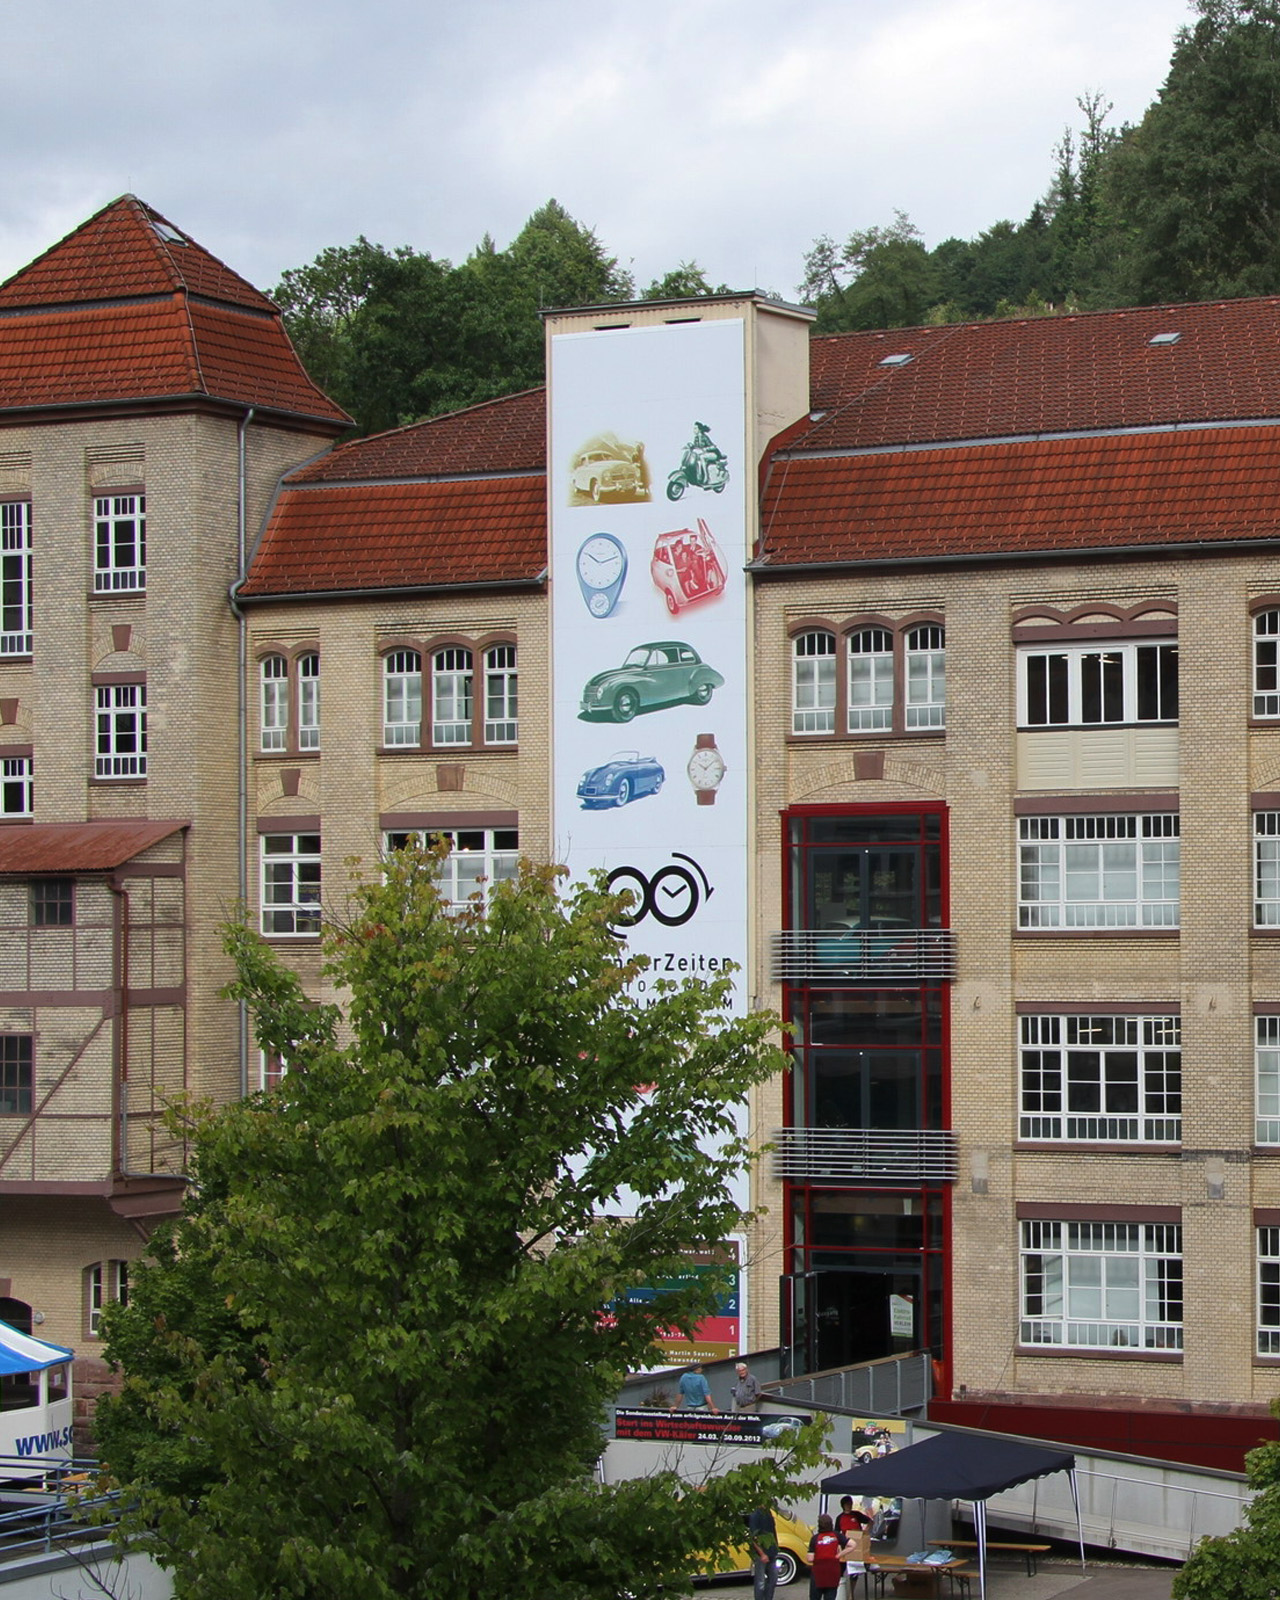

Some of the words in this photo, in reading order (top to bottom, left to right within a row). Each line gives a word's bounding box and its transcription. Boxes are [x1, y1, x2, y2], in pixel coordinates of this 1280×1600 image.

[728, 1273, 736, 1286] 3
[728, 1298, 736, 1310] 2
[729, 1324, 735, 1336] 1
[625, 1410, 671, 1419] Sonderausstellung
[616, 1418, 639, 1428] Start
[641, 1420, 654, 1428] ins
[616, 1428, 630, 1437] mit
[633, 1429, 652, 1438] dem
[697, 1433, 719, 1441] 24.03.
